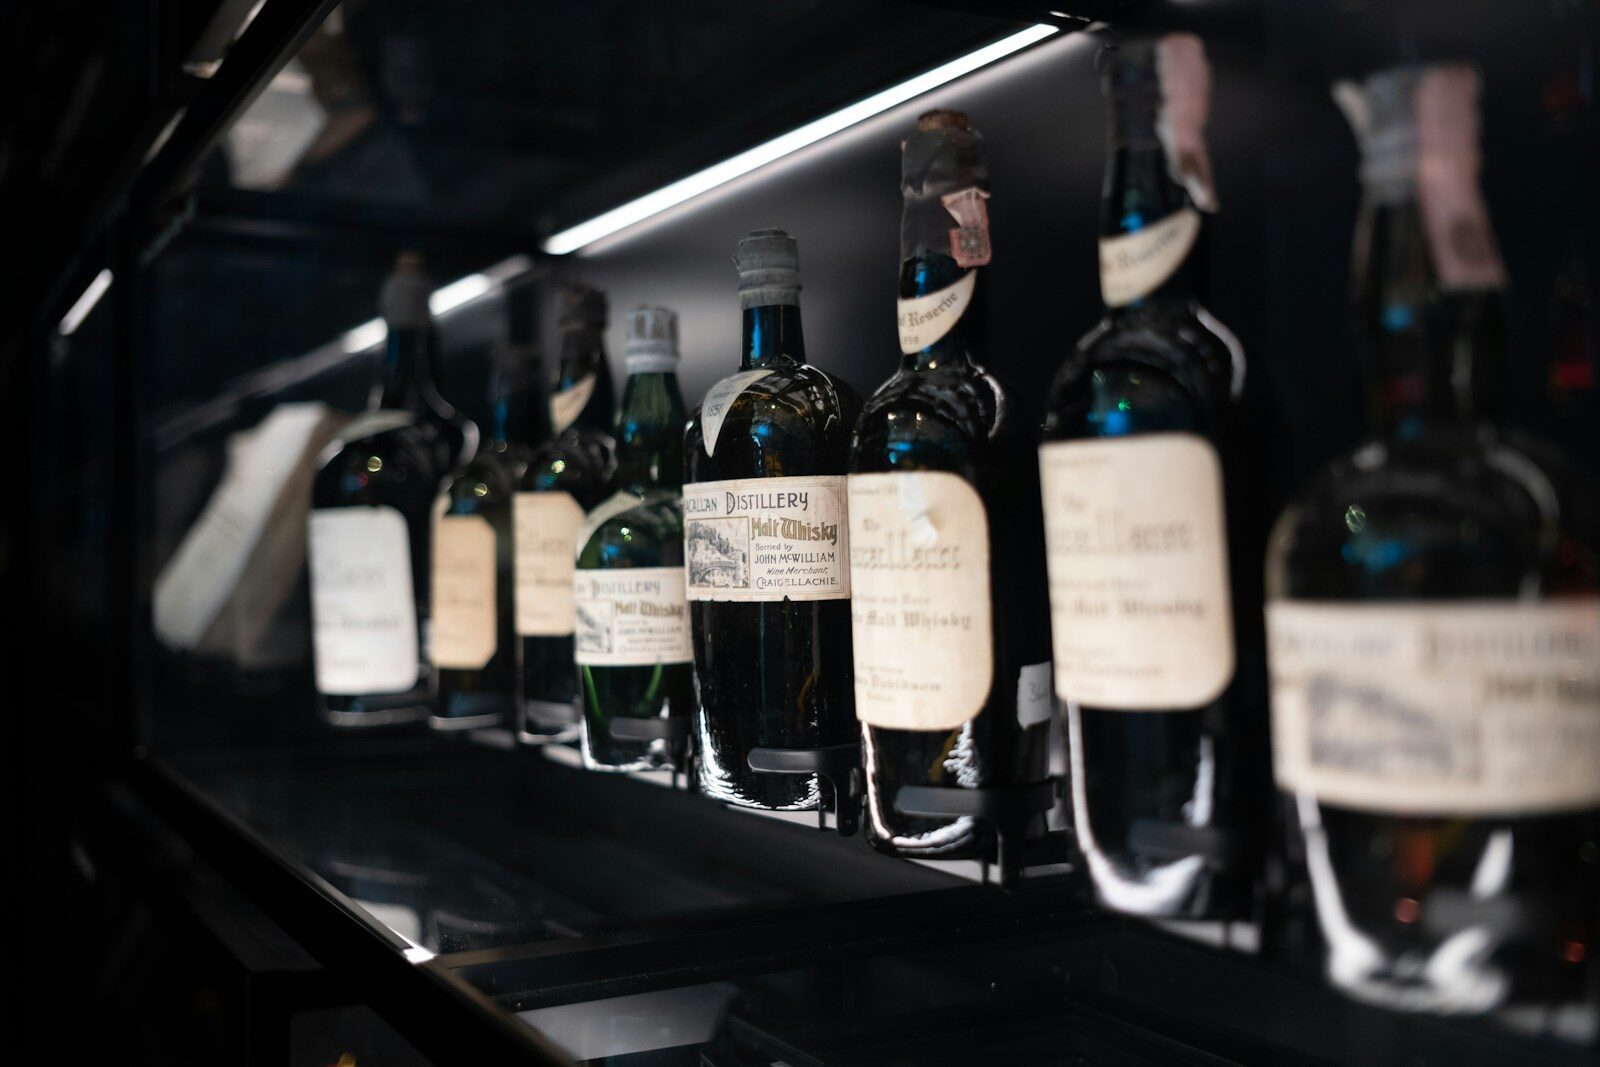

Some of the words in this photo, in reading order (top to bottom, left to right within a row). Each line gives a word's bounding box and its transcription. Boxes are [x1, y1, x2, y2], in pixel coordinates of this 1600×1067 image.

[725, 491, 808, 515] DISTILLERY
[751, 517, 780, 541] Malt
[780, 517, 838, 546] Whisky
[783, 543, 794, 552] by
[754, 553, 777, 565] JOHN
[903, 610, 972, 631] Whisky
